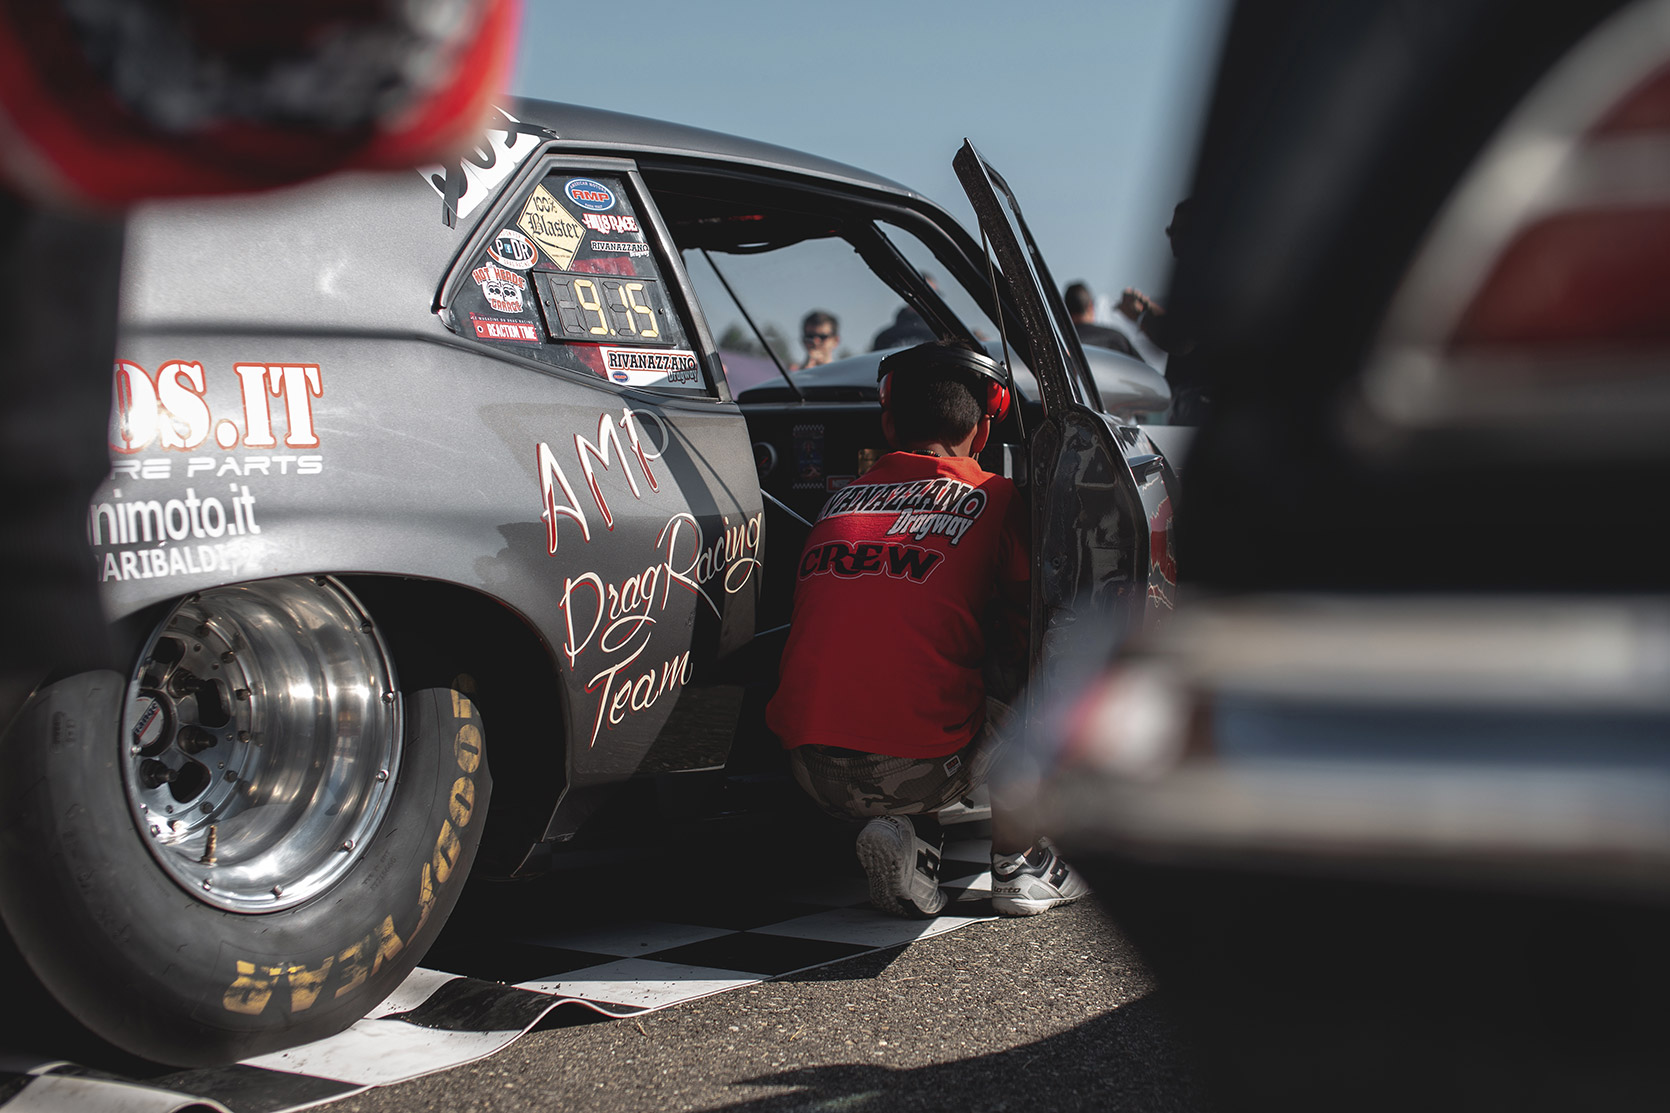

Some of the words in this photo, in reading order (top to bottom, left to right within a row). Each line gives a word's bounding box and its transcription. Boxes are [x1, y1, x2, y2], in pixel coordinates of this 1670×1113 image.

[533, 196, 557, 213] 100%
[572, 190, 609, 202] AMP
[526, 212, 579, 239] Blaster
[592, 242, 649, 252] RIVANAZZANO
[473, 267, 491, 283] HOT
[494, 267, 525, 289] HEADS
[491, 298, 523, 312] GARAGE
[487, 324, 520, 338] REACTION
[519, 326, 537, 339] TIME
[609, 353, 696, 370] RIVANAZZANO
[668, 368, 698, 384] Dragway
[187, 455, 323, 477] PARTS
[537, 406, 669, 557] AMP
[88, 483, 261, 546] nimoto.it
[886, 507, 974, 545] Dragway
[802, 543, 943, 581] CREW
[586, 631, 693, 749] Team
